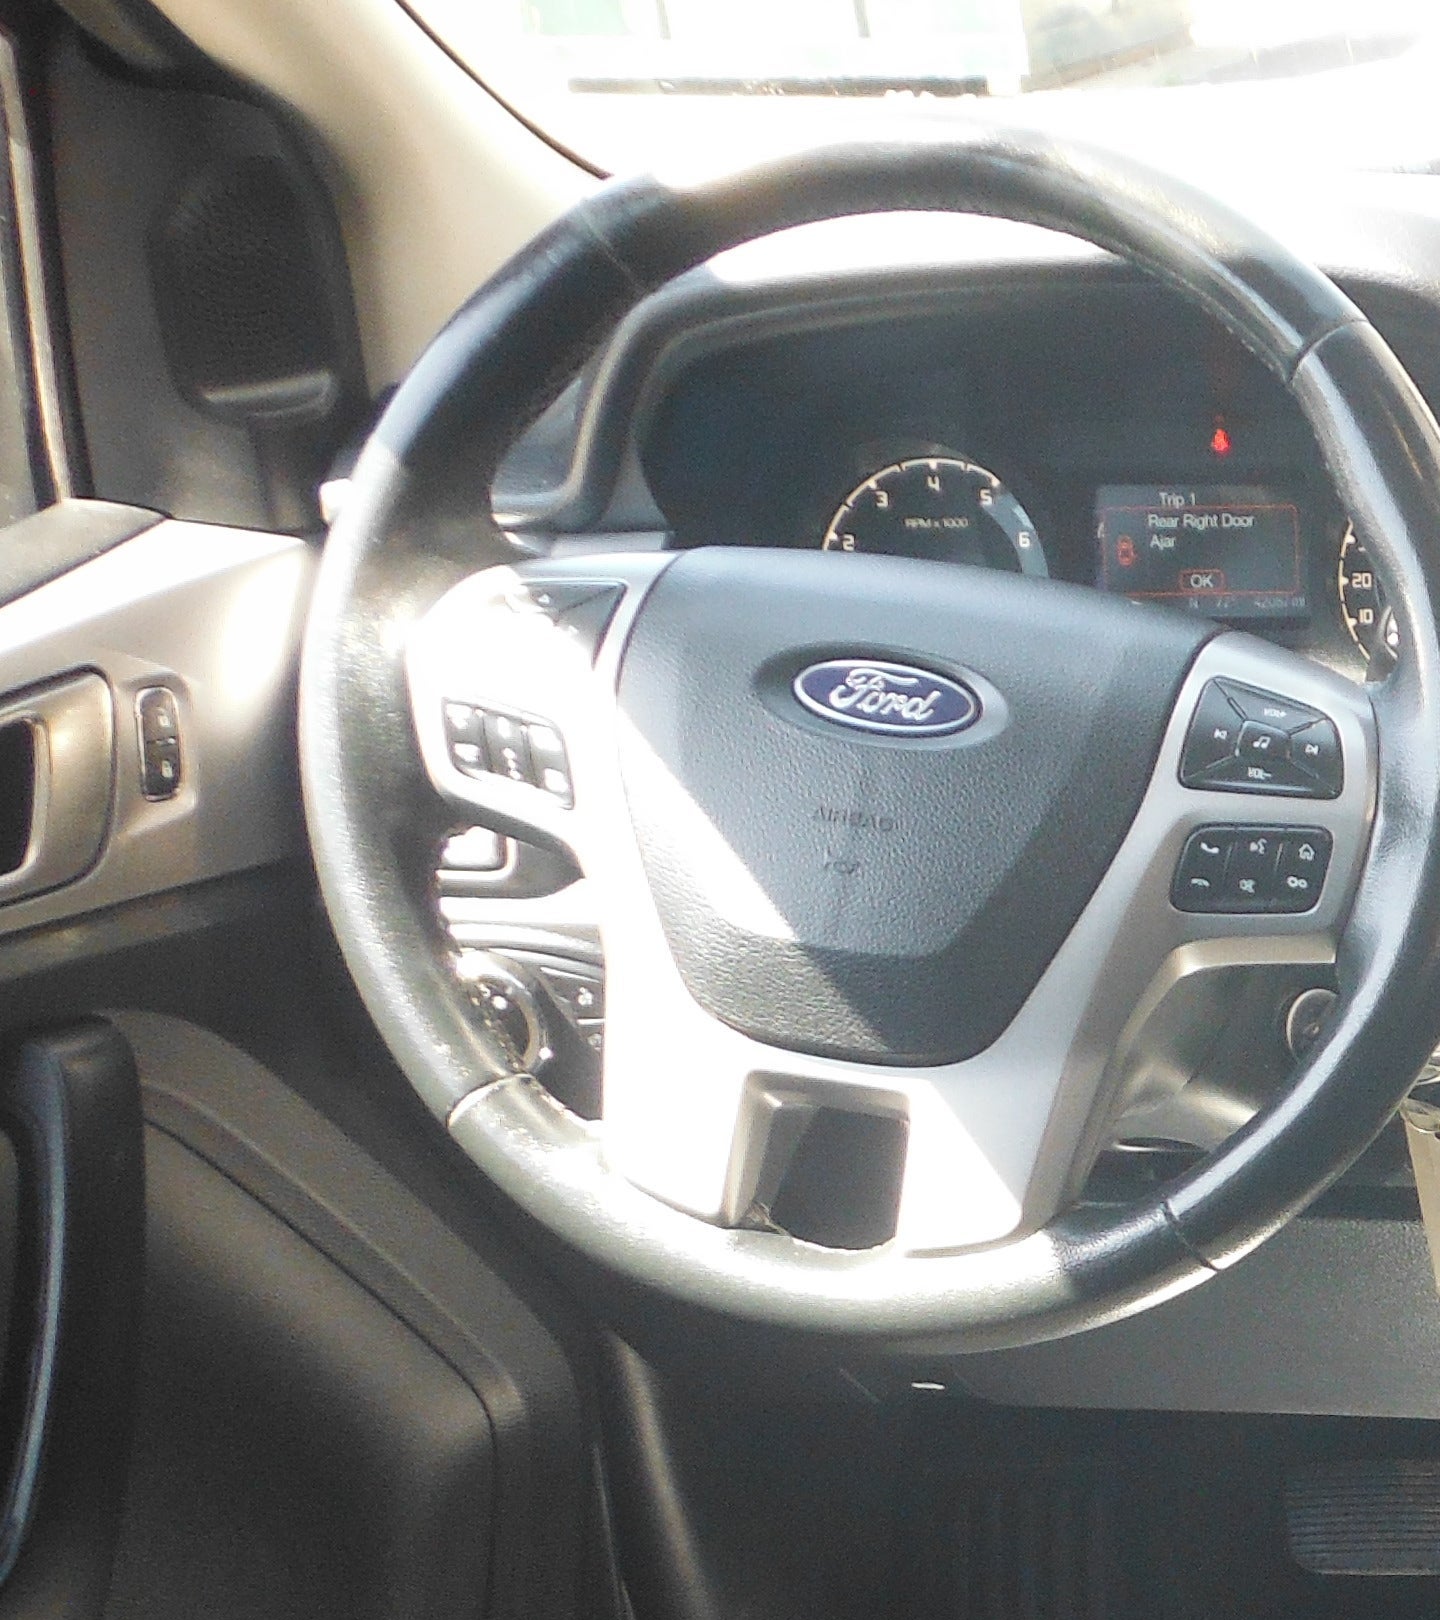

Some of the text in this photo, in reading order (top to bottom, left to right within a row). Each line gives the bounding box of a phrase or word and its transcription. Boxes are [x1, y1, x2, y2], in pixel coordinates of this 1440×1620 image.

[927, 475, 940, 491] 4
[875, 490, 889, 508] 3
[980, 489, 993, 505] 5
[1158, 491, 1197, 509] Trip 1
[904, 517, 932, 529] RPM
[942, 517, 970, 529] 1000
[1148, 512, 1255, 531] Rear Right Door
[842, 534, 856, 551] 2
[1018, 531, 1031, 548] 6
[1149, 533, 1177, 551] Ajar
[1189, 573, 1214, 589] OK
[1351, 572, 1373, 589] 20
[1358, 608, 1374, 624] 10
[829, 667, 942, 722] Ford
